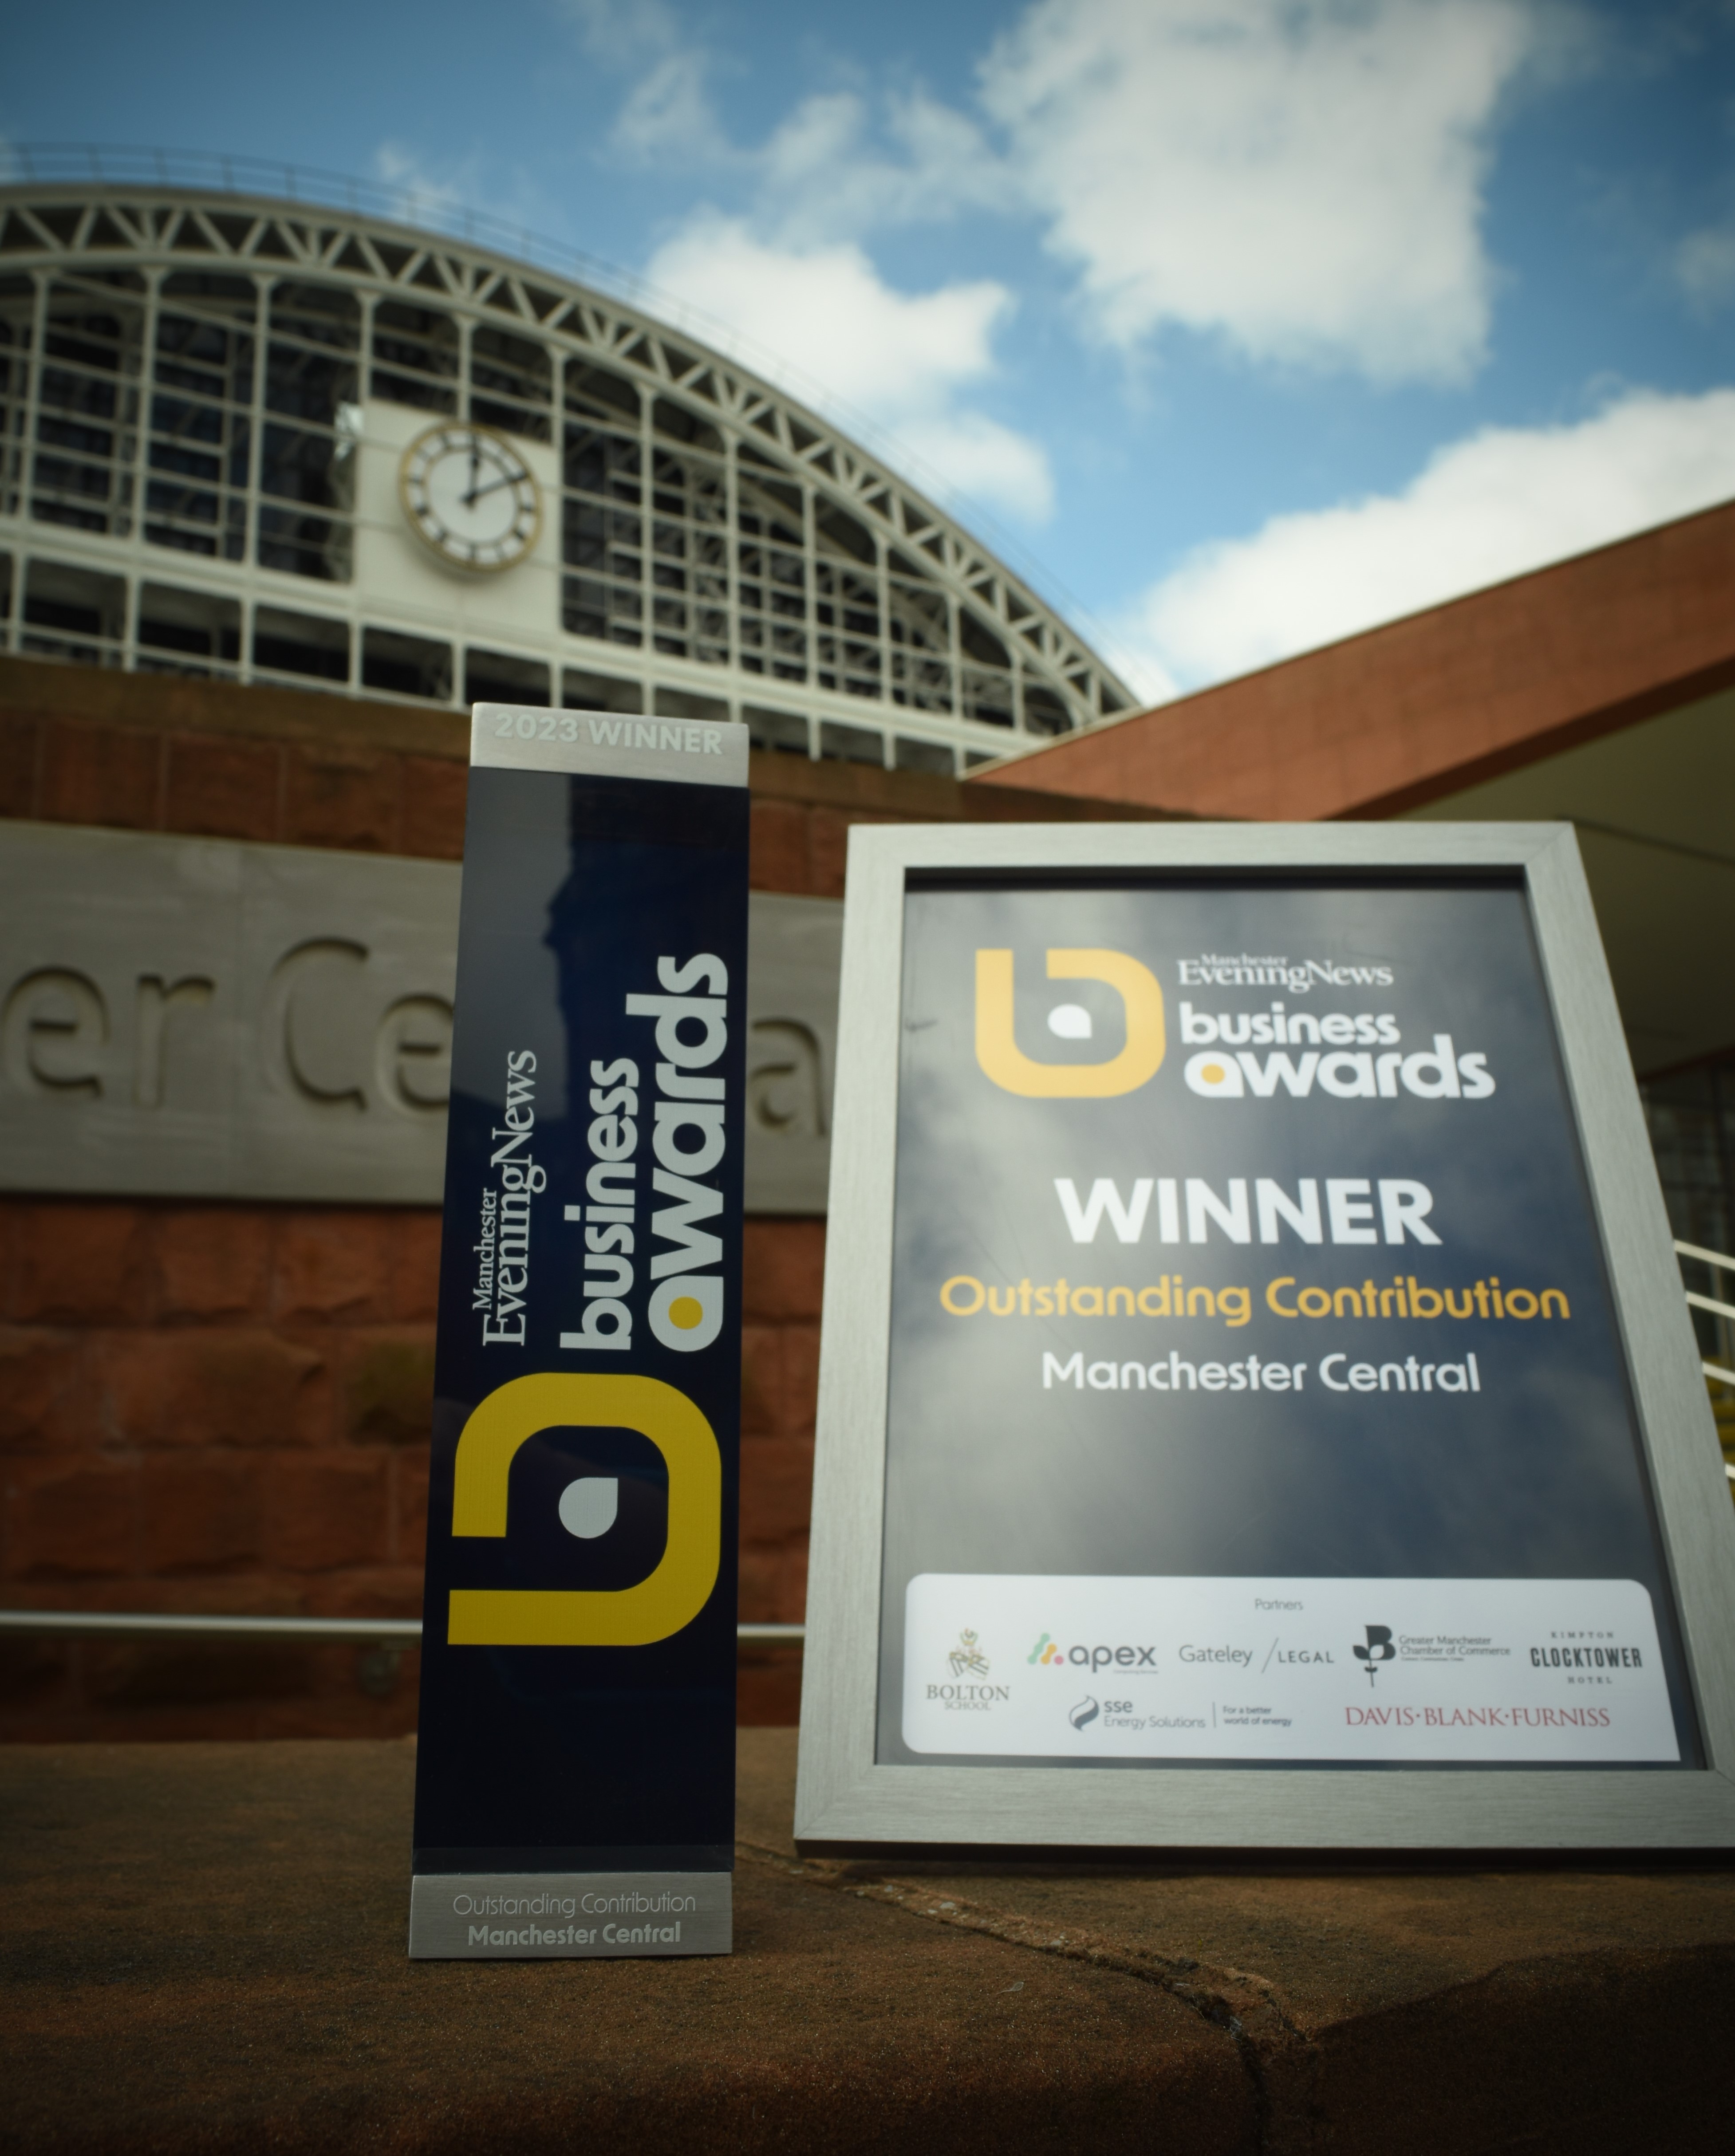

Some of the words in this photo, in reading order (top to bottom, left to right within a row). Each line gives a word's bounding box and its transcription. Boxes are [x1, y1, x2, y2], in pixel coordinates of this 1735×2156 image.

[494, 712, 578, 743] 2023
[588, 719, 722, 754] WINNER
[1201, 953, 1287, 966] Manchester
[1179, 1002, 1400, 1045] business
[1184, 1034, 1496, 1099] awards
[626, 953, 728, 1352] awards
[560, 1058, 639, 1350] business
[1054, 1178, 1443, 1245] WINNER
[473, 1188, 497, 1310] Manchester
[939, 1274, 1251, 1327] Outstanding
[1265, 1276, 1571, 1320] Contribution
[1042, 1352, 1307, 1391] Manchester
[1319, 1352, 1480, 1392] Central
[1254, 1598, 1303, 1610] Partners
[1399, 1636, 1433, 1644] Greater
[1437, 1636, 1491, 1644] Manchester
[1400, 1646, 1443, 1655] Chamber
[1459, 1646, 1511, 1655] Commerce
[1069, 1646, 1156, 1673] apex
[1179, 1644, 1252, 1667] Gateley
[1278, 1651, 1334, 1663] LEGAL
[1530, 1648, 1642, 1667] CLOCKTOWER
[927, 1685, 1010, 1700] BOLTON
[945, 1701, 991, 1710] SCHOOL
[1104, 1701, 1132, 1713] sse
[1104, 1716, 1146, 1730] Energy
[1149, 1716, 1206, 1728] Solutions
[453, 1893, 576, 1918] Outstanding
[581, 1892, 696, 1914] Contribution
[468, 1925, 597, 1946] Manchester
[603, 1921, 681, 1944] Central
